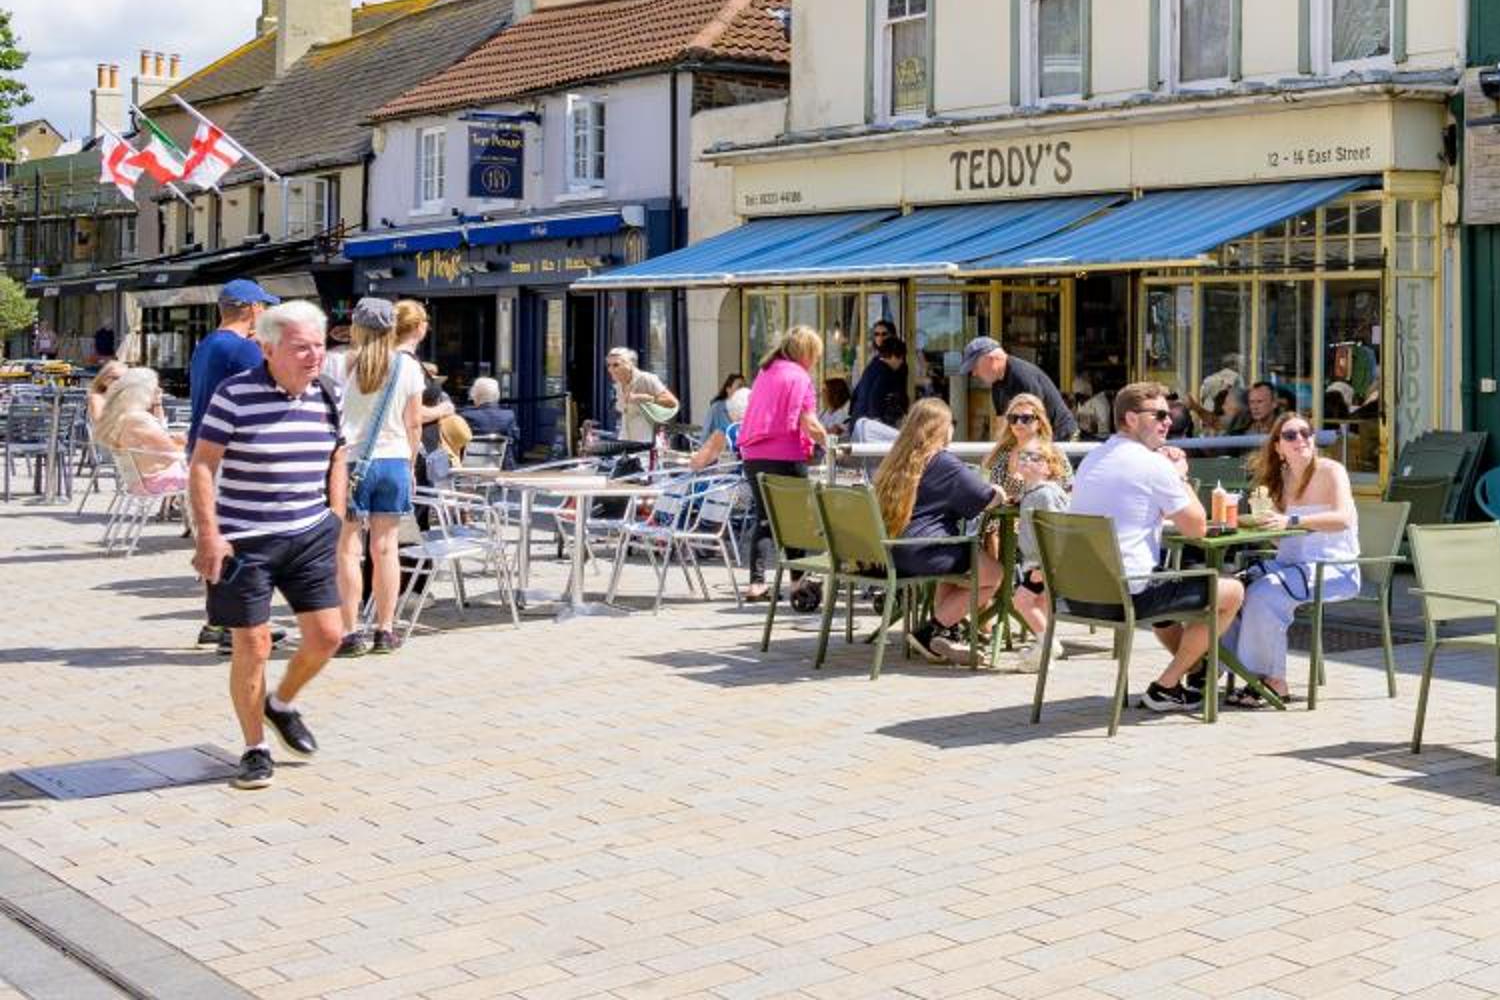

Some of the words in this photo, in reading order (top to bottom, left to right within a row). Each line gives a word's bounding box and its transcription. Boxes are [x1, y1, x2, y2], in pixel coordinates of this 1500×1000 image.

[949, 140, 1073, 191] TEDDY'S
[1307, 147, 1332, 165] East
[1335, 145, 1372, 162] Street
